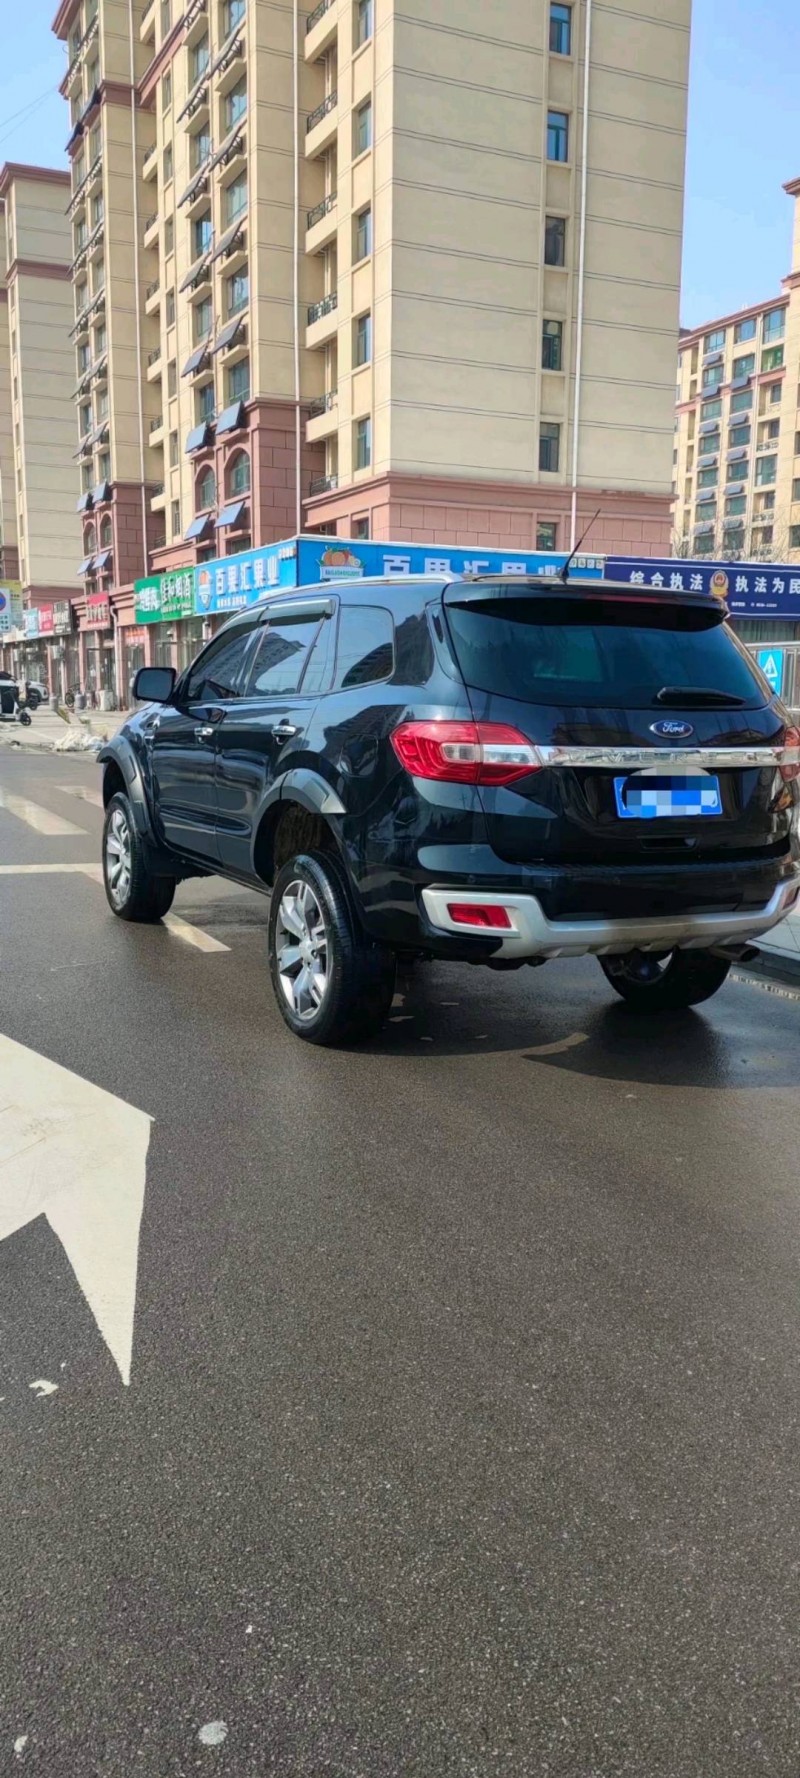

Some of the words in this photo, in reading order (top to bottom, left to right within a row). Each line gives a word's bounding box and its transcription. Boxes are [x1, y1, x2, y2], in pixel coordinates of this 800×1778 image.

[214, 554, 279, 595] 百果汇果业
[629, 570, 704, 591] 综合执法
[735, 575, 800, 595] 执法为民
[661, 721, 685, 733] Ford
